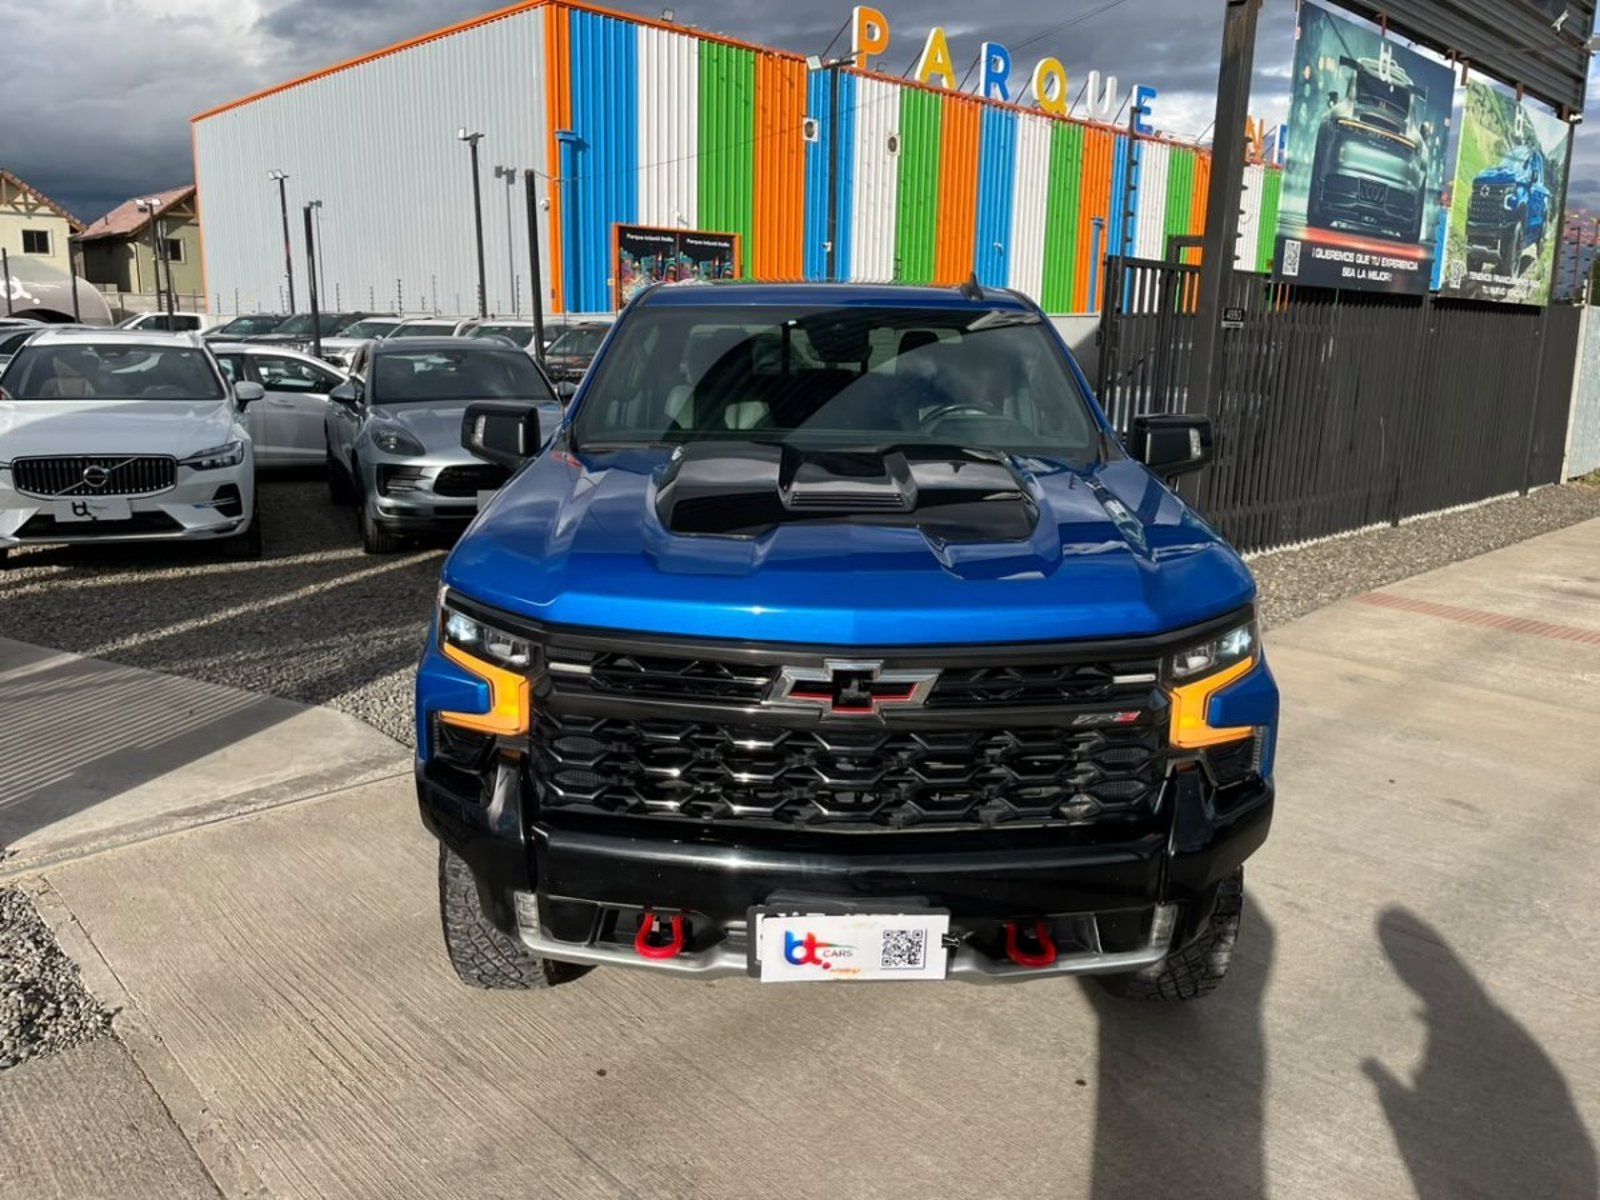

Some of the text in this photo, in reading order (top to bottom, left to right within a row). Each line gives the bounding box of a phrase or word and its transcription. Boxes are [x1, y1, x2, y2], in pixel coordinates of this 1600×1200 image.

[852, 6, 1157, 136] PARQUE
[1356, 253, 1370, 265] QUE
[1371, 255, 1380, 267] TU
[1342, 266, 1355, 278] SEA
[1357, 269, 1366, 279] LA
[822, 949, 854, 959] CARS
